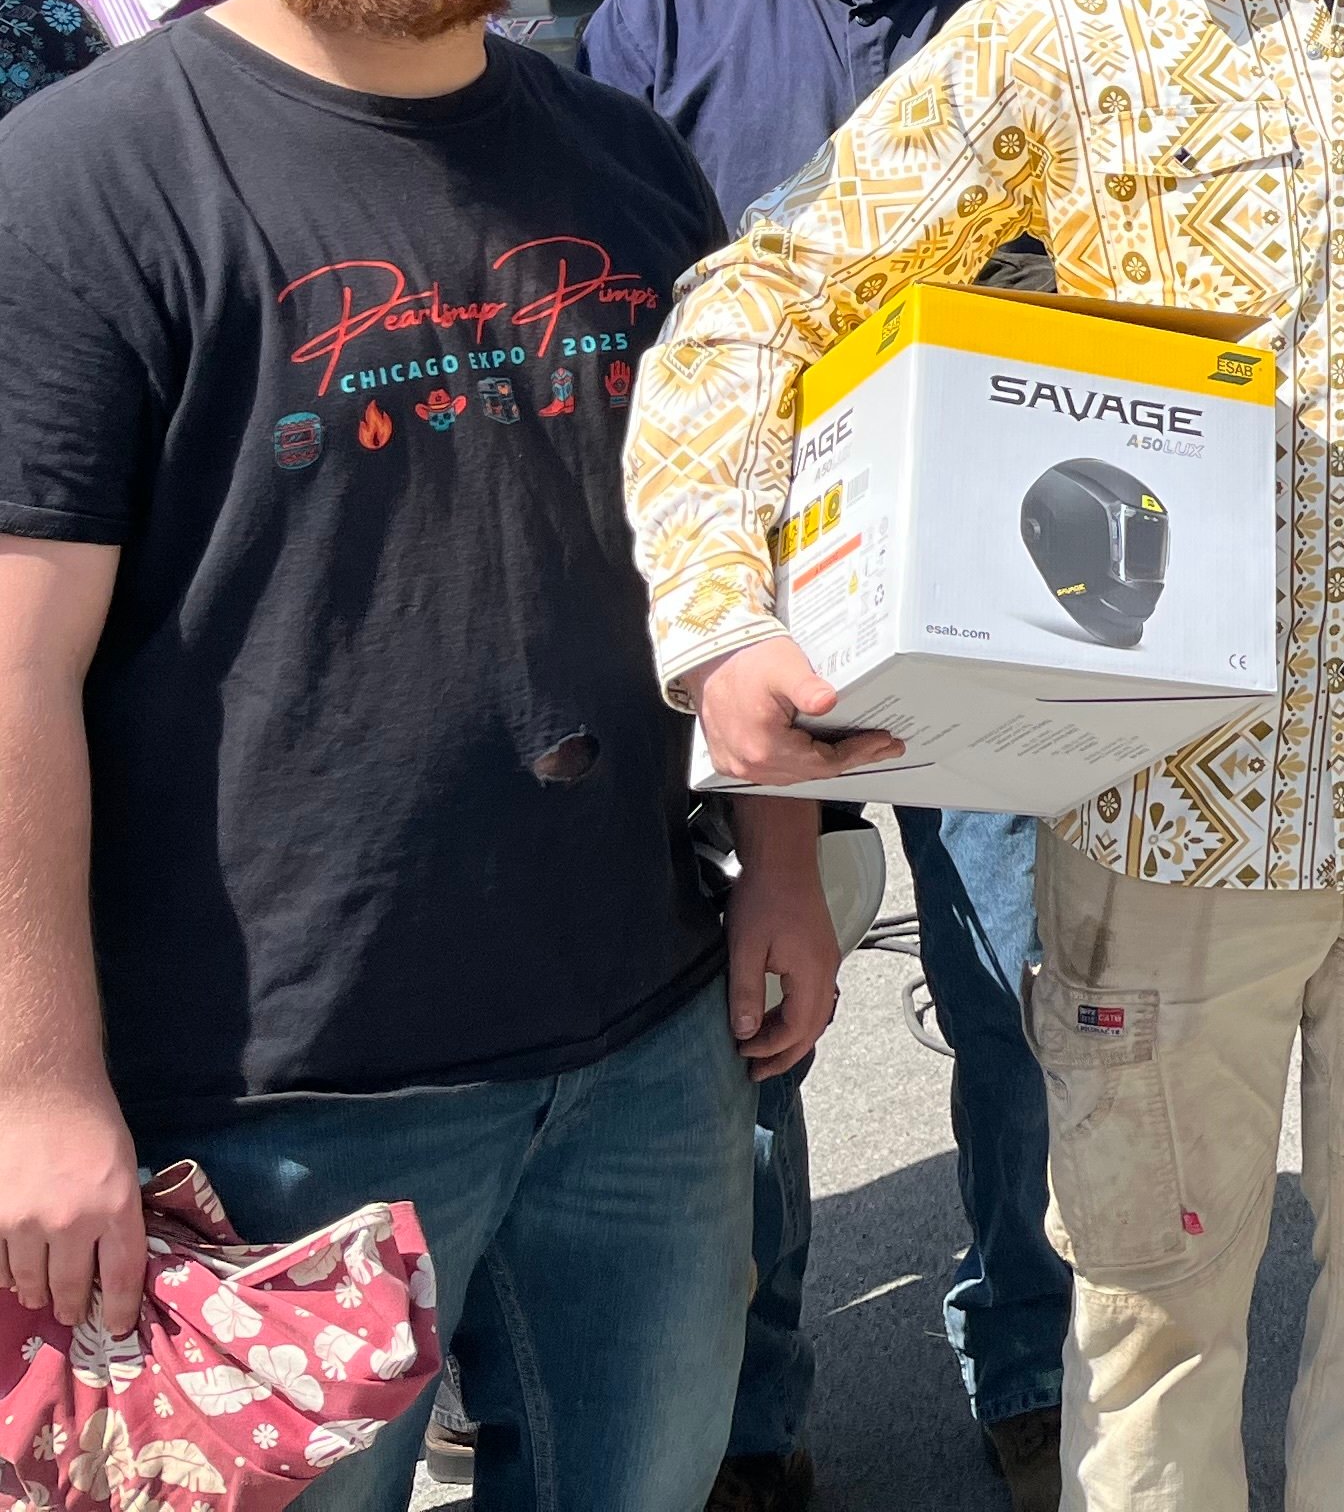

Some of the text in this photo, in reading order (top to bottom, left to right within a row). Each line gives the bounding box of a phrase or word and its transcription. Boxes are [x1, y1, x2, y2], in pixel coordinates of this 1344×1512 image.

[277, 235, 659, 397] Pearlsnap Pimps
[340, 332, 629, 393] CHICAGO EXPO 2025
[1216, 357, 1254, 378] ESAB
[989, 374, 1205, 437] SAVAGE
[926, 622, 991, 641] esab.com
